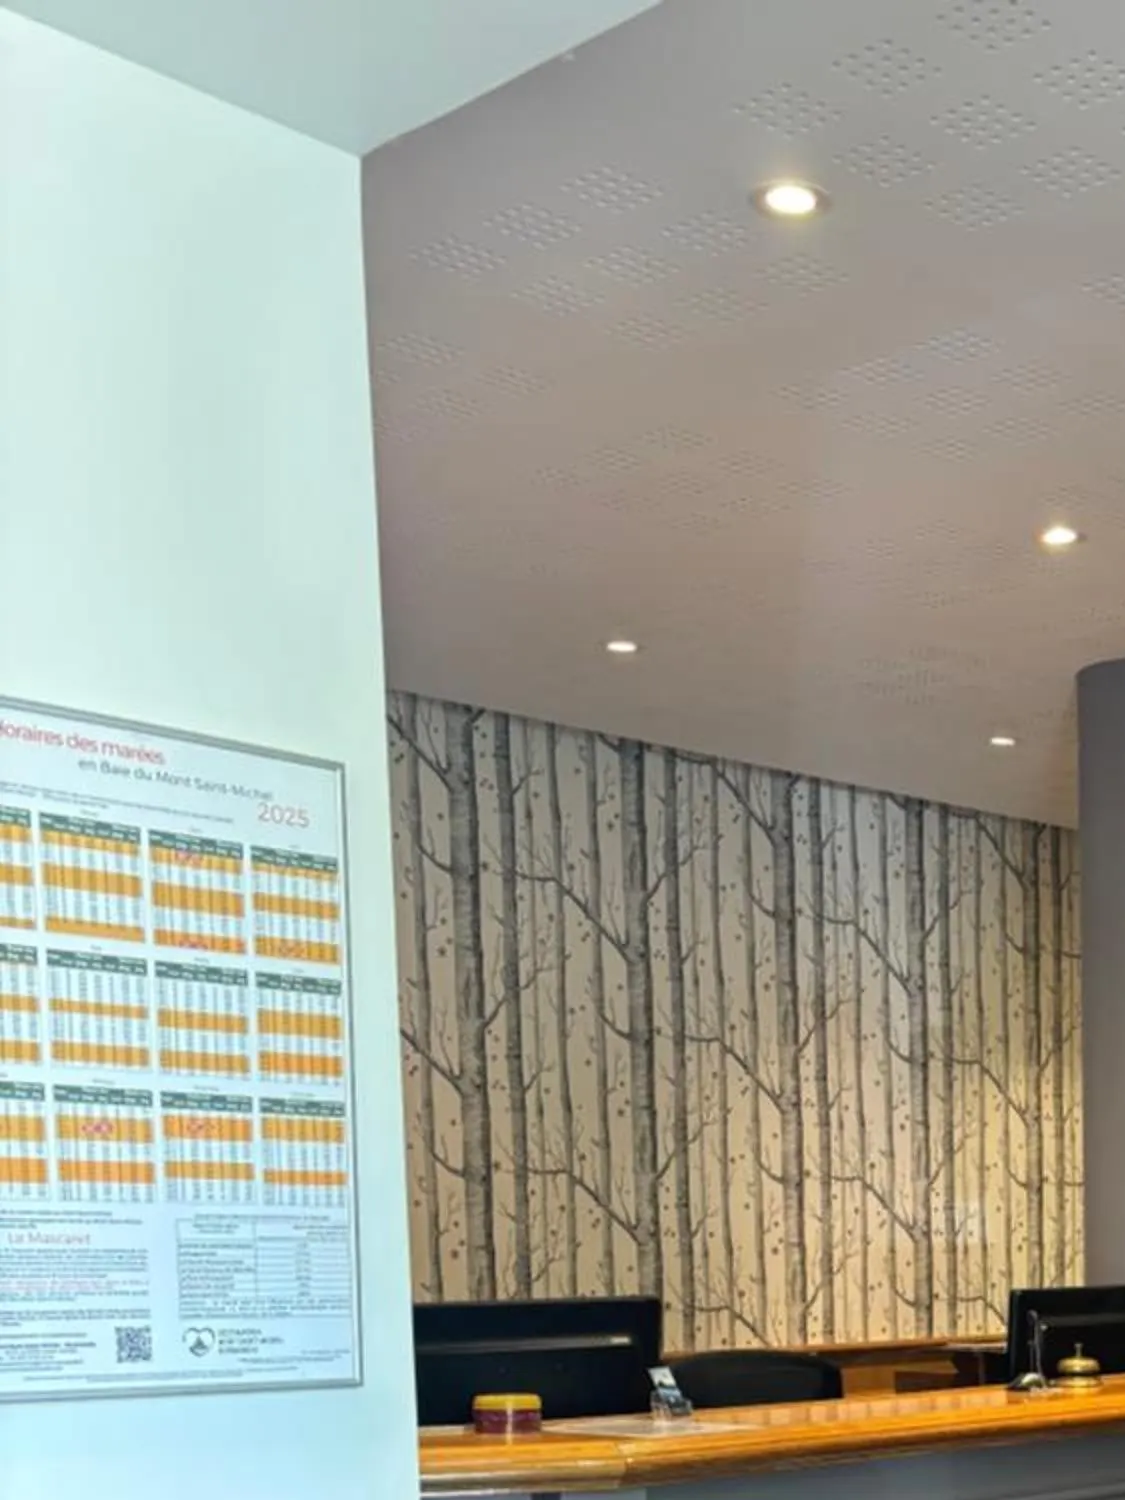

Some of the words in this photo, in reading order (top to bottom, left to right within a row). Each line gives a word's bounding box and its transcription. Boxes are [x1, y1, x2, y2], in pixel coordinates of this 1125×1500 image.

[66, 734, 98, 753] des
[101, 741, 165, 764] marées
[78, 759, 97, 772] en
[100, 761, 130, 777] Baie
[133, 768, 152, 781] du
[156, 771, 190, 788] Mont
[257, 802, 310, 828] 2025
